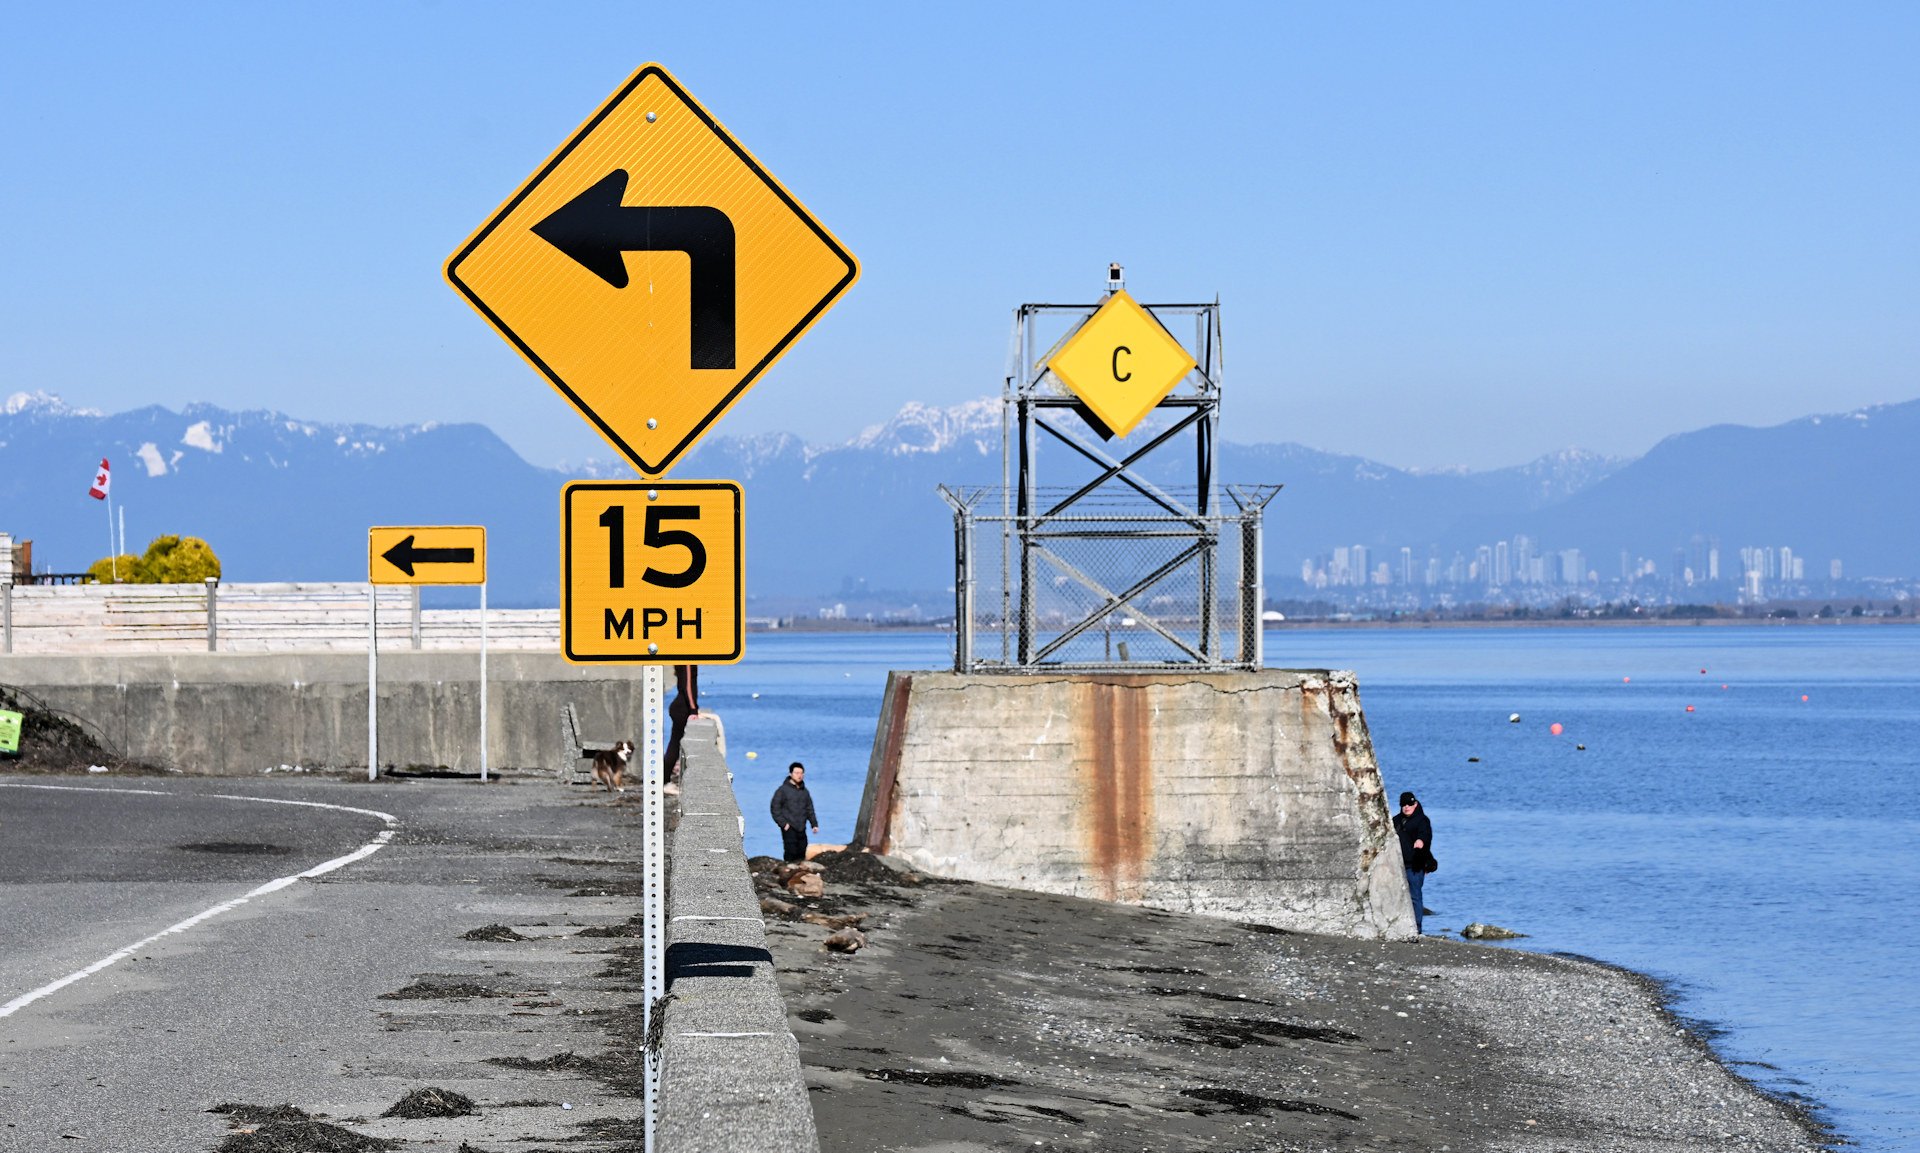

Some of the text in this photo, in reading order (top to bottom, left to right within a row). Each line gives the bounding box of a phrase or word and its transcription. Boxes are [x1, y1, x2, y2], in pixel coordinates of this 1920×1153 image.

[1112, 345, 1132, 383] C
[599, 505, 707, 589] 15
[604, 607, 702, 640] MPH
